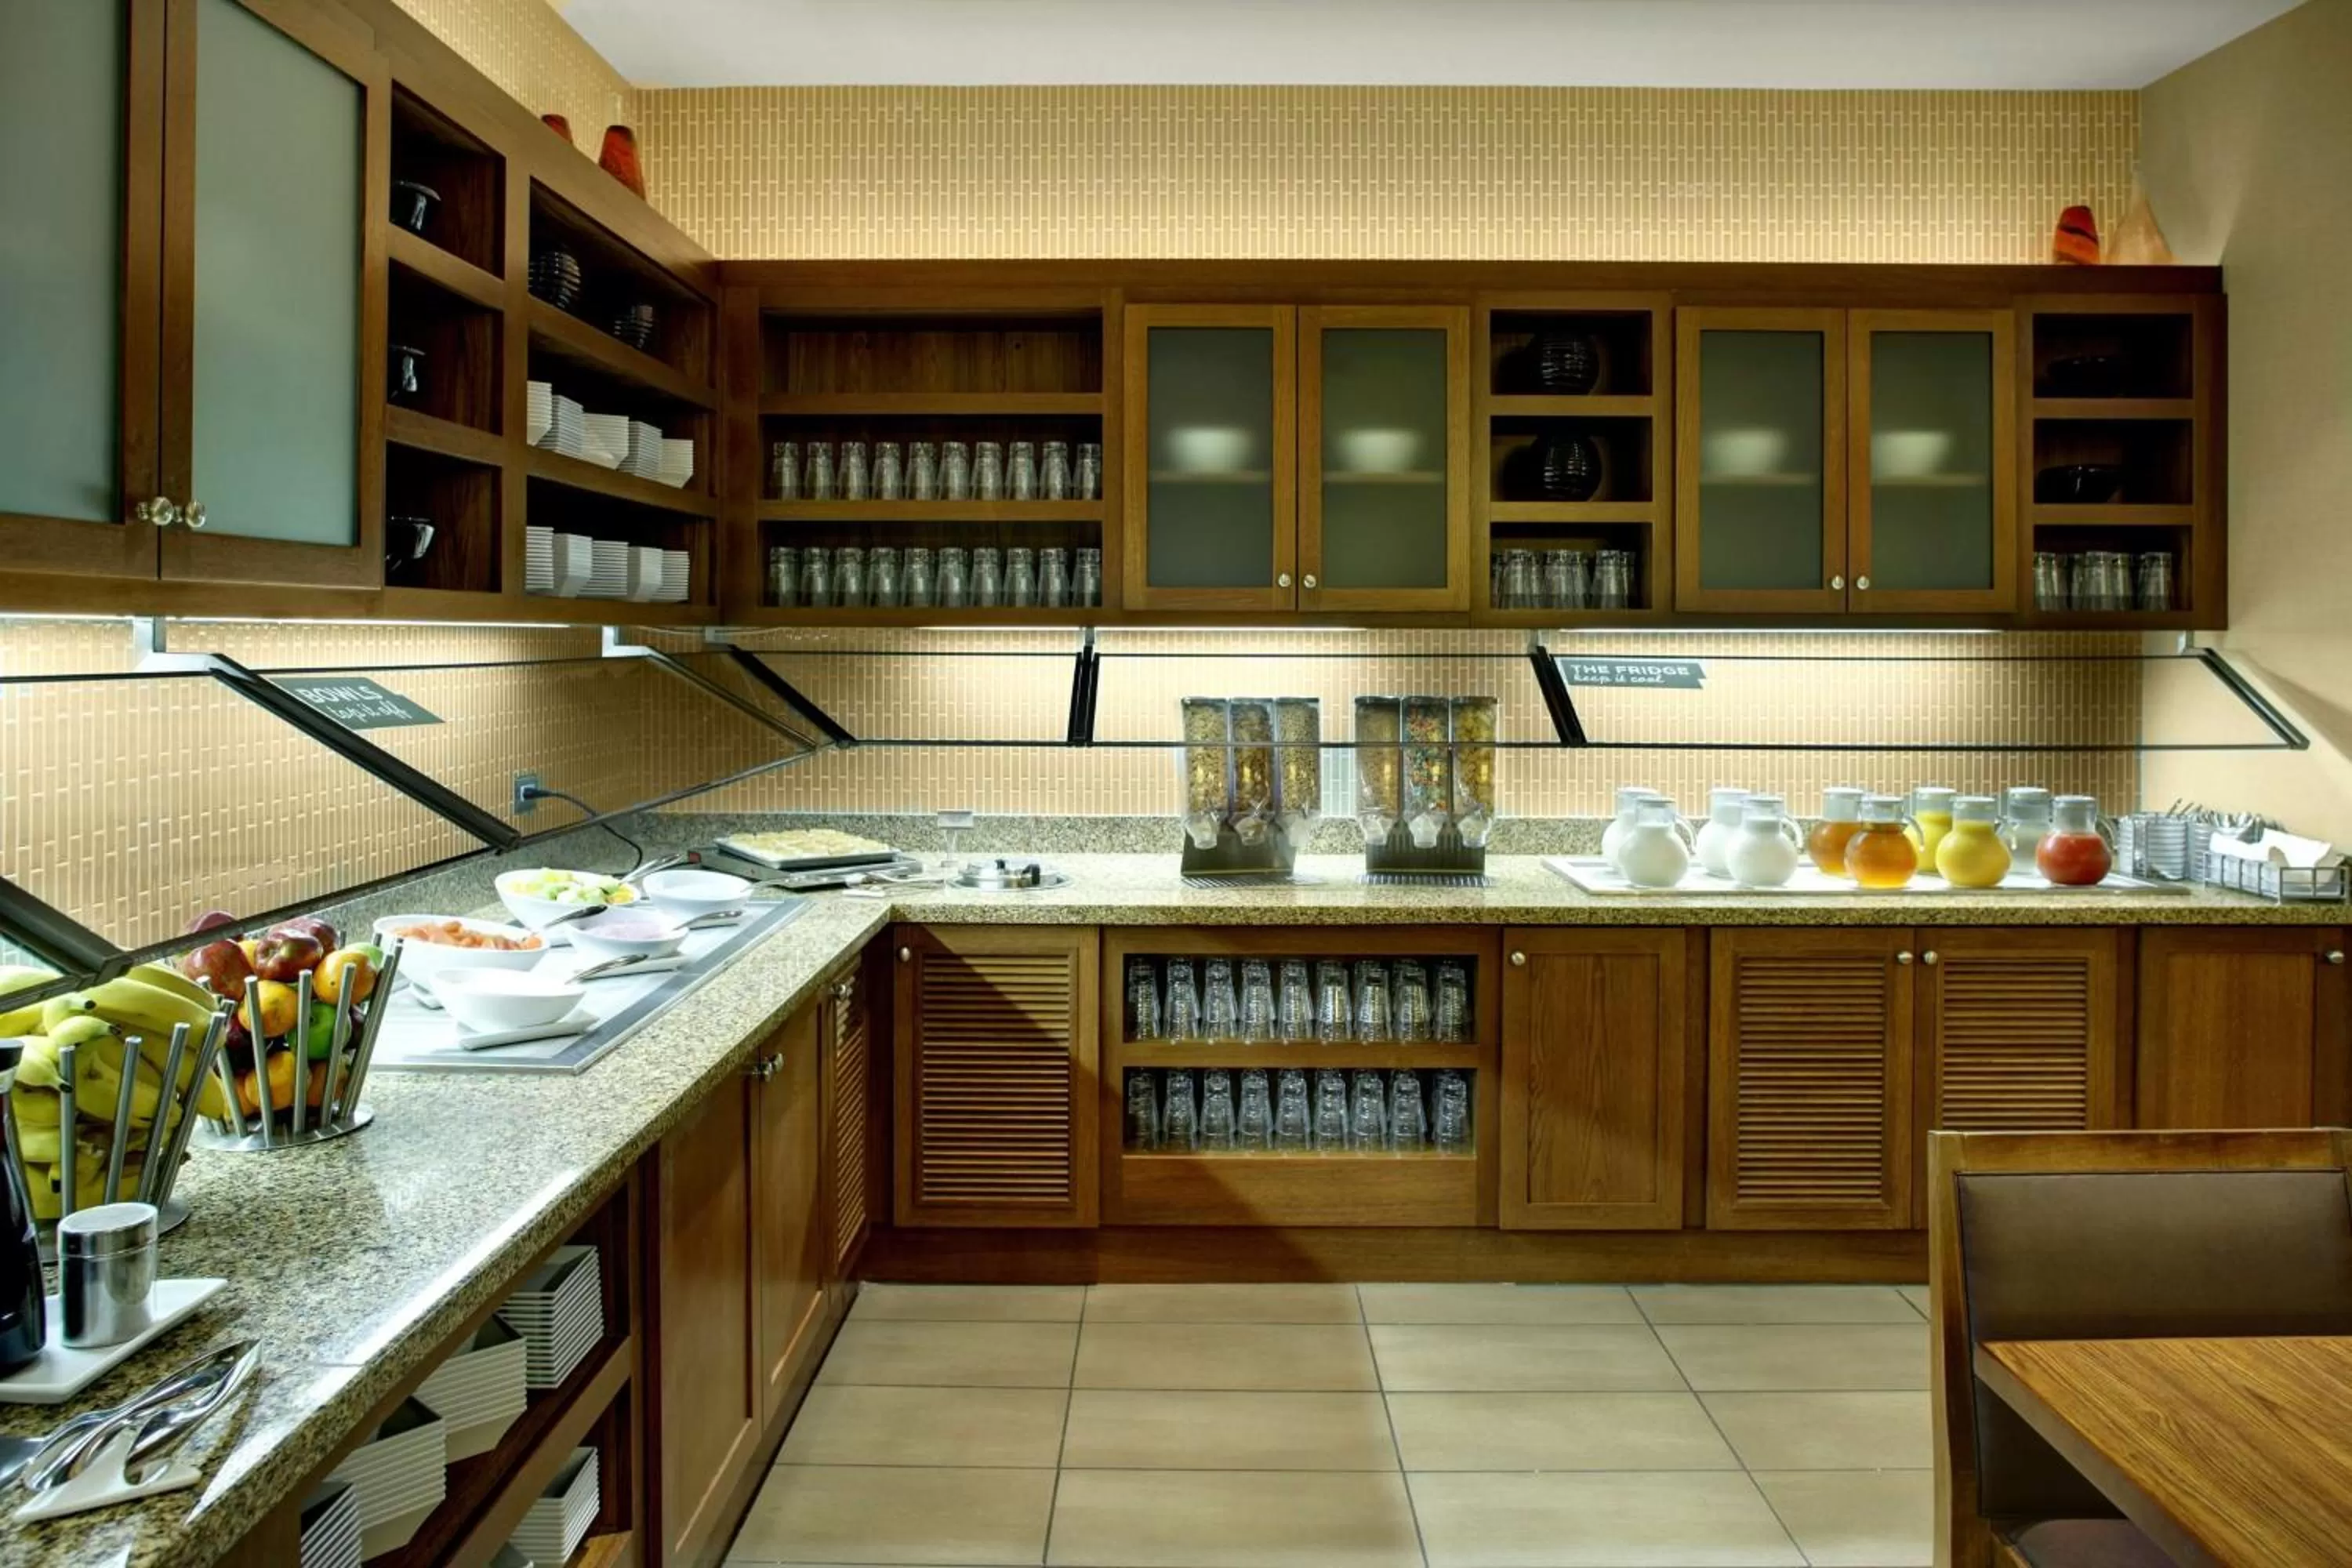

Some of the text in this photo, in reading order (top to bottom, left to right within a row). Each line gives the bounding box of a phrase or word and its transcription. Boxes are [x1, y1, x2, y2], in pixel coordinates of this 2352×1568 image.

[1571, 665, 1690, 675] THE FRIDGE
[1573, 674, 1610, 684] keep
[295, 686, 383, 702] BOWLS
